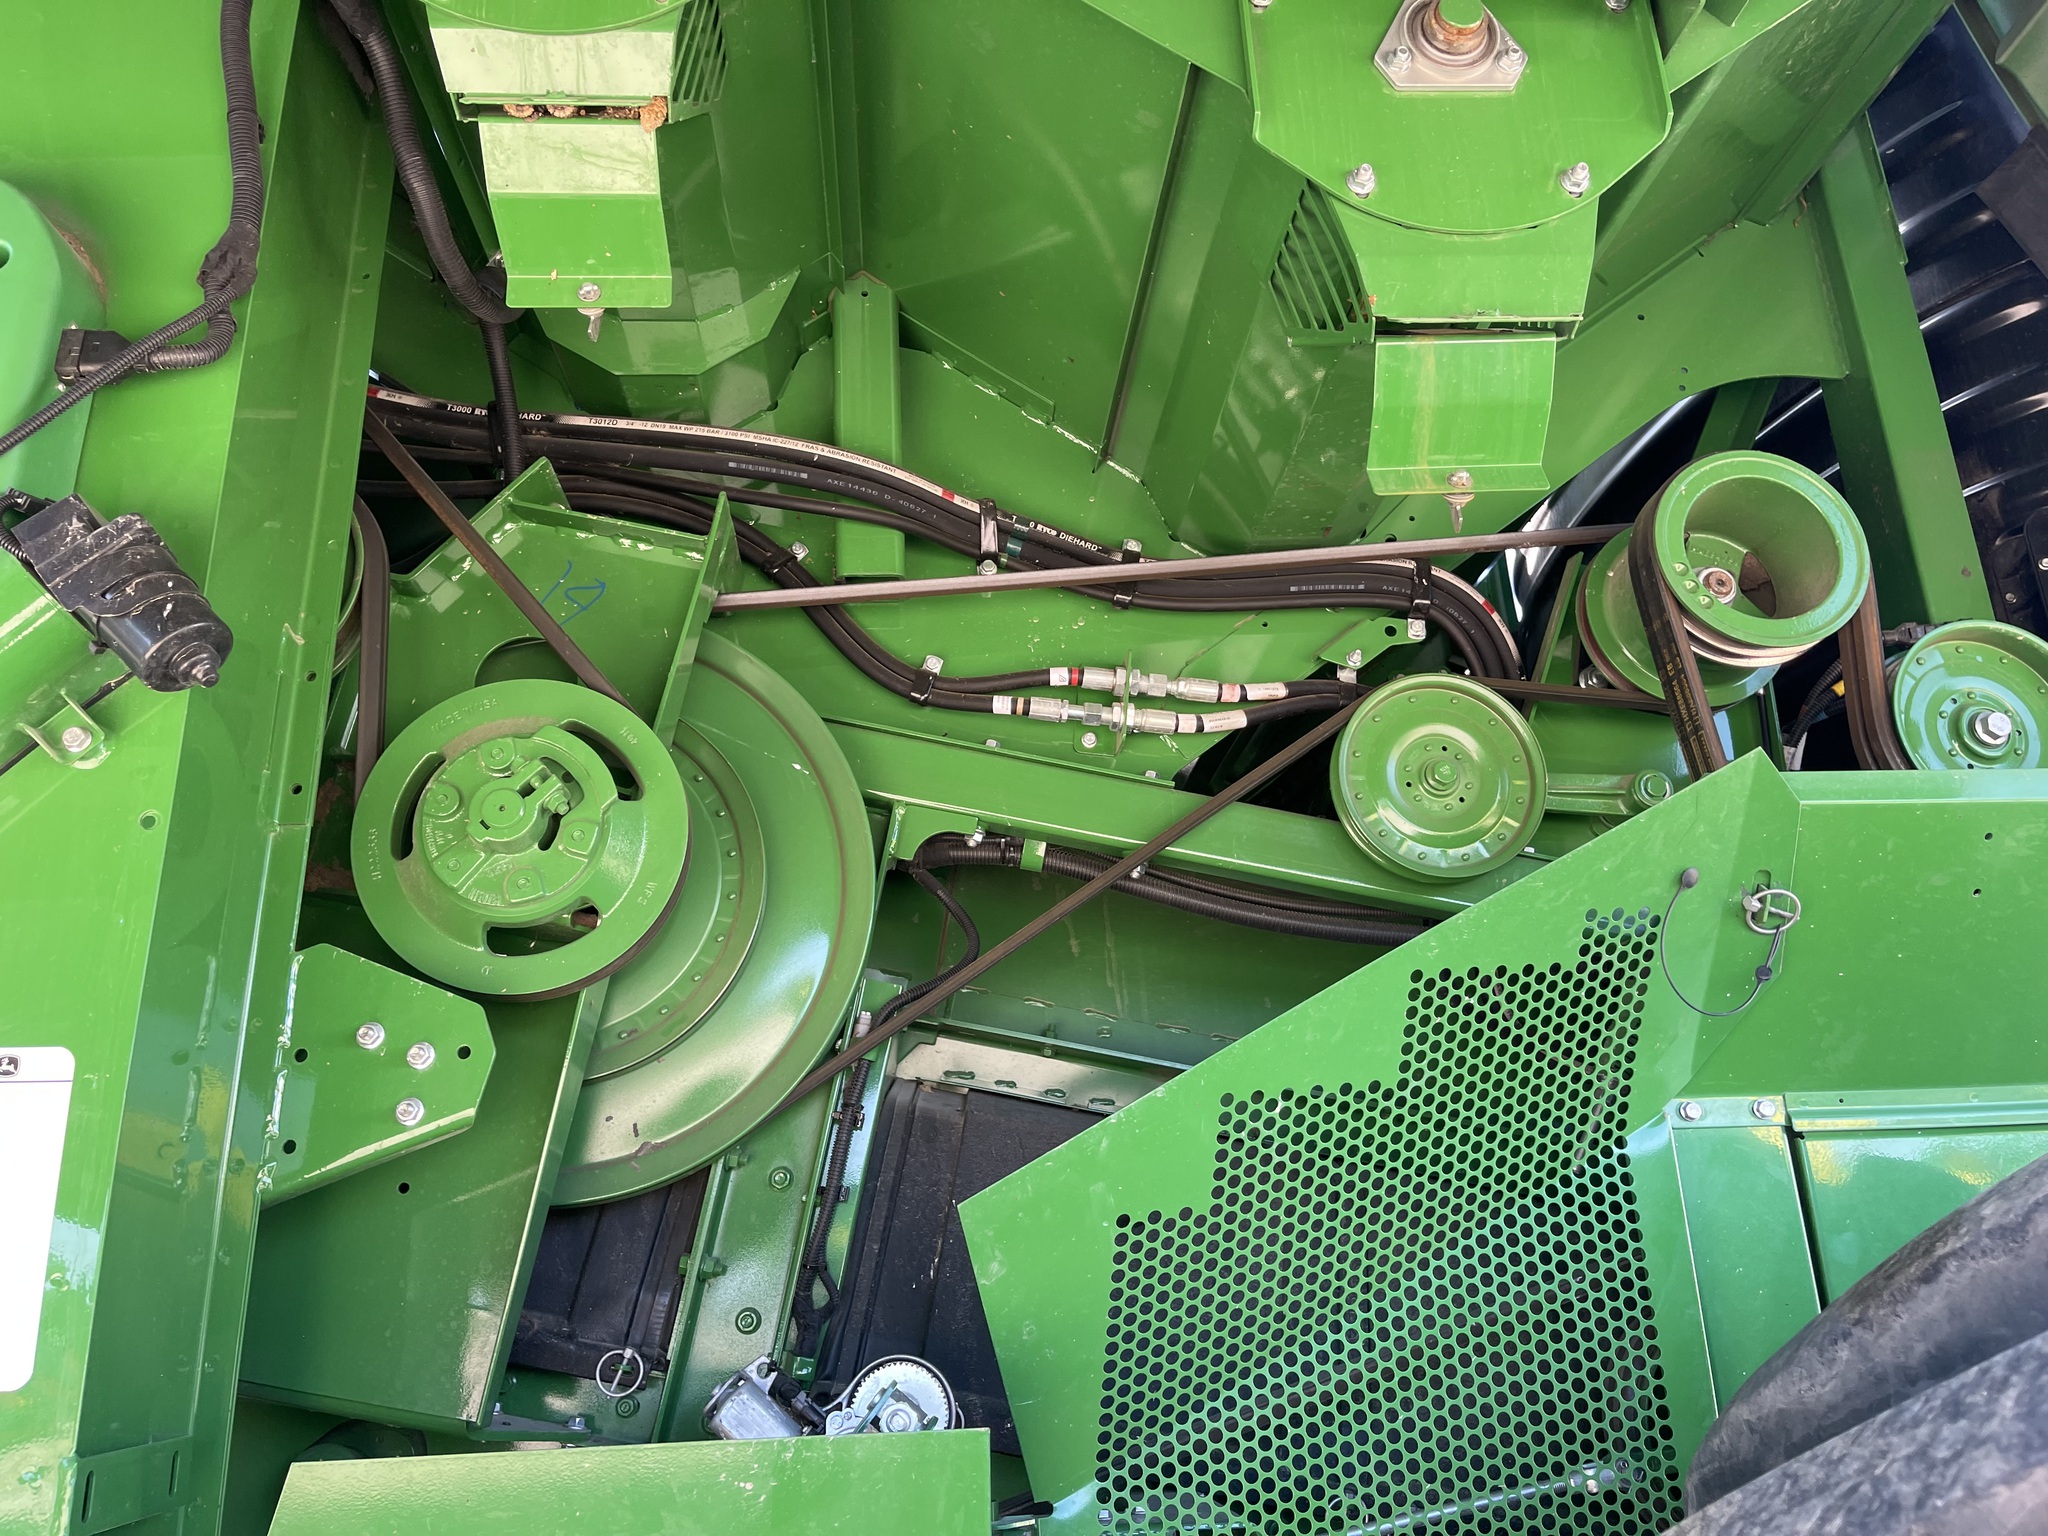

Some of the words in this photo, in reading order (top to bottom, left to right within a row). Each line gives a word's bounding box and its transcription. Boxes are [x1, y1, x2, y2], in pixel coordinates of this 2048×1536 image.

[446, 403, 473, 414] T3000
[588, 417, 618, 426] T3012D
[752, 434, 772, 442] MSHA
[826, 449, 861, 462] ABRASION
[861, 458, 897, 474] RESISTANT
[1059, 530, 1099, 552] DIEHARD
